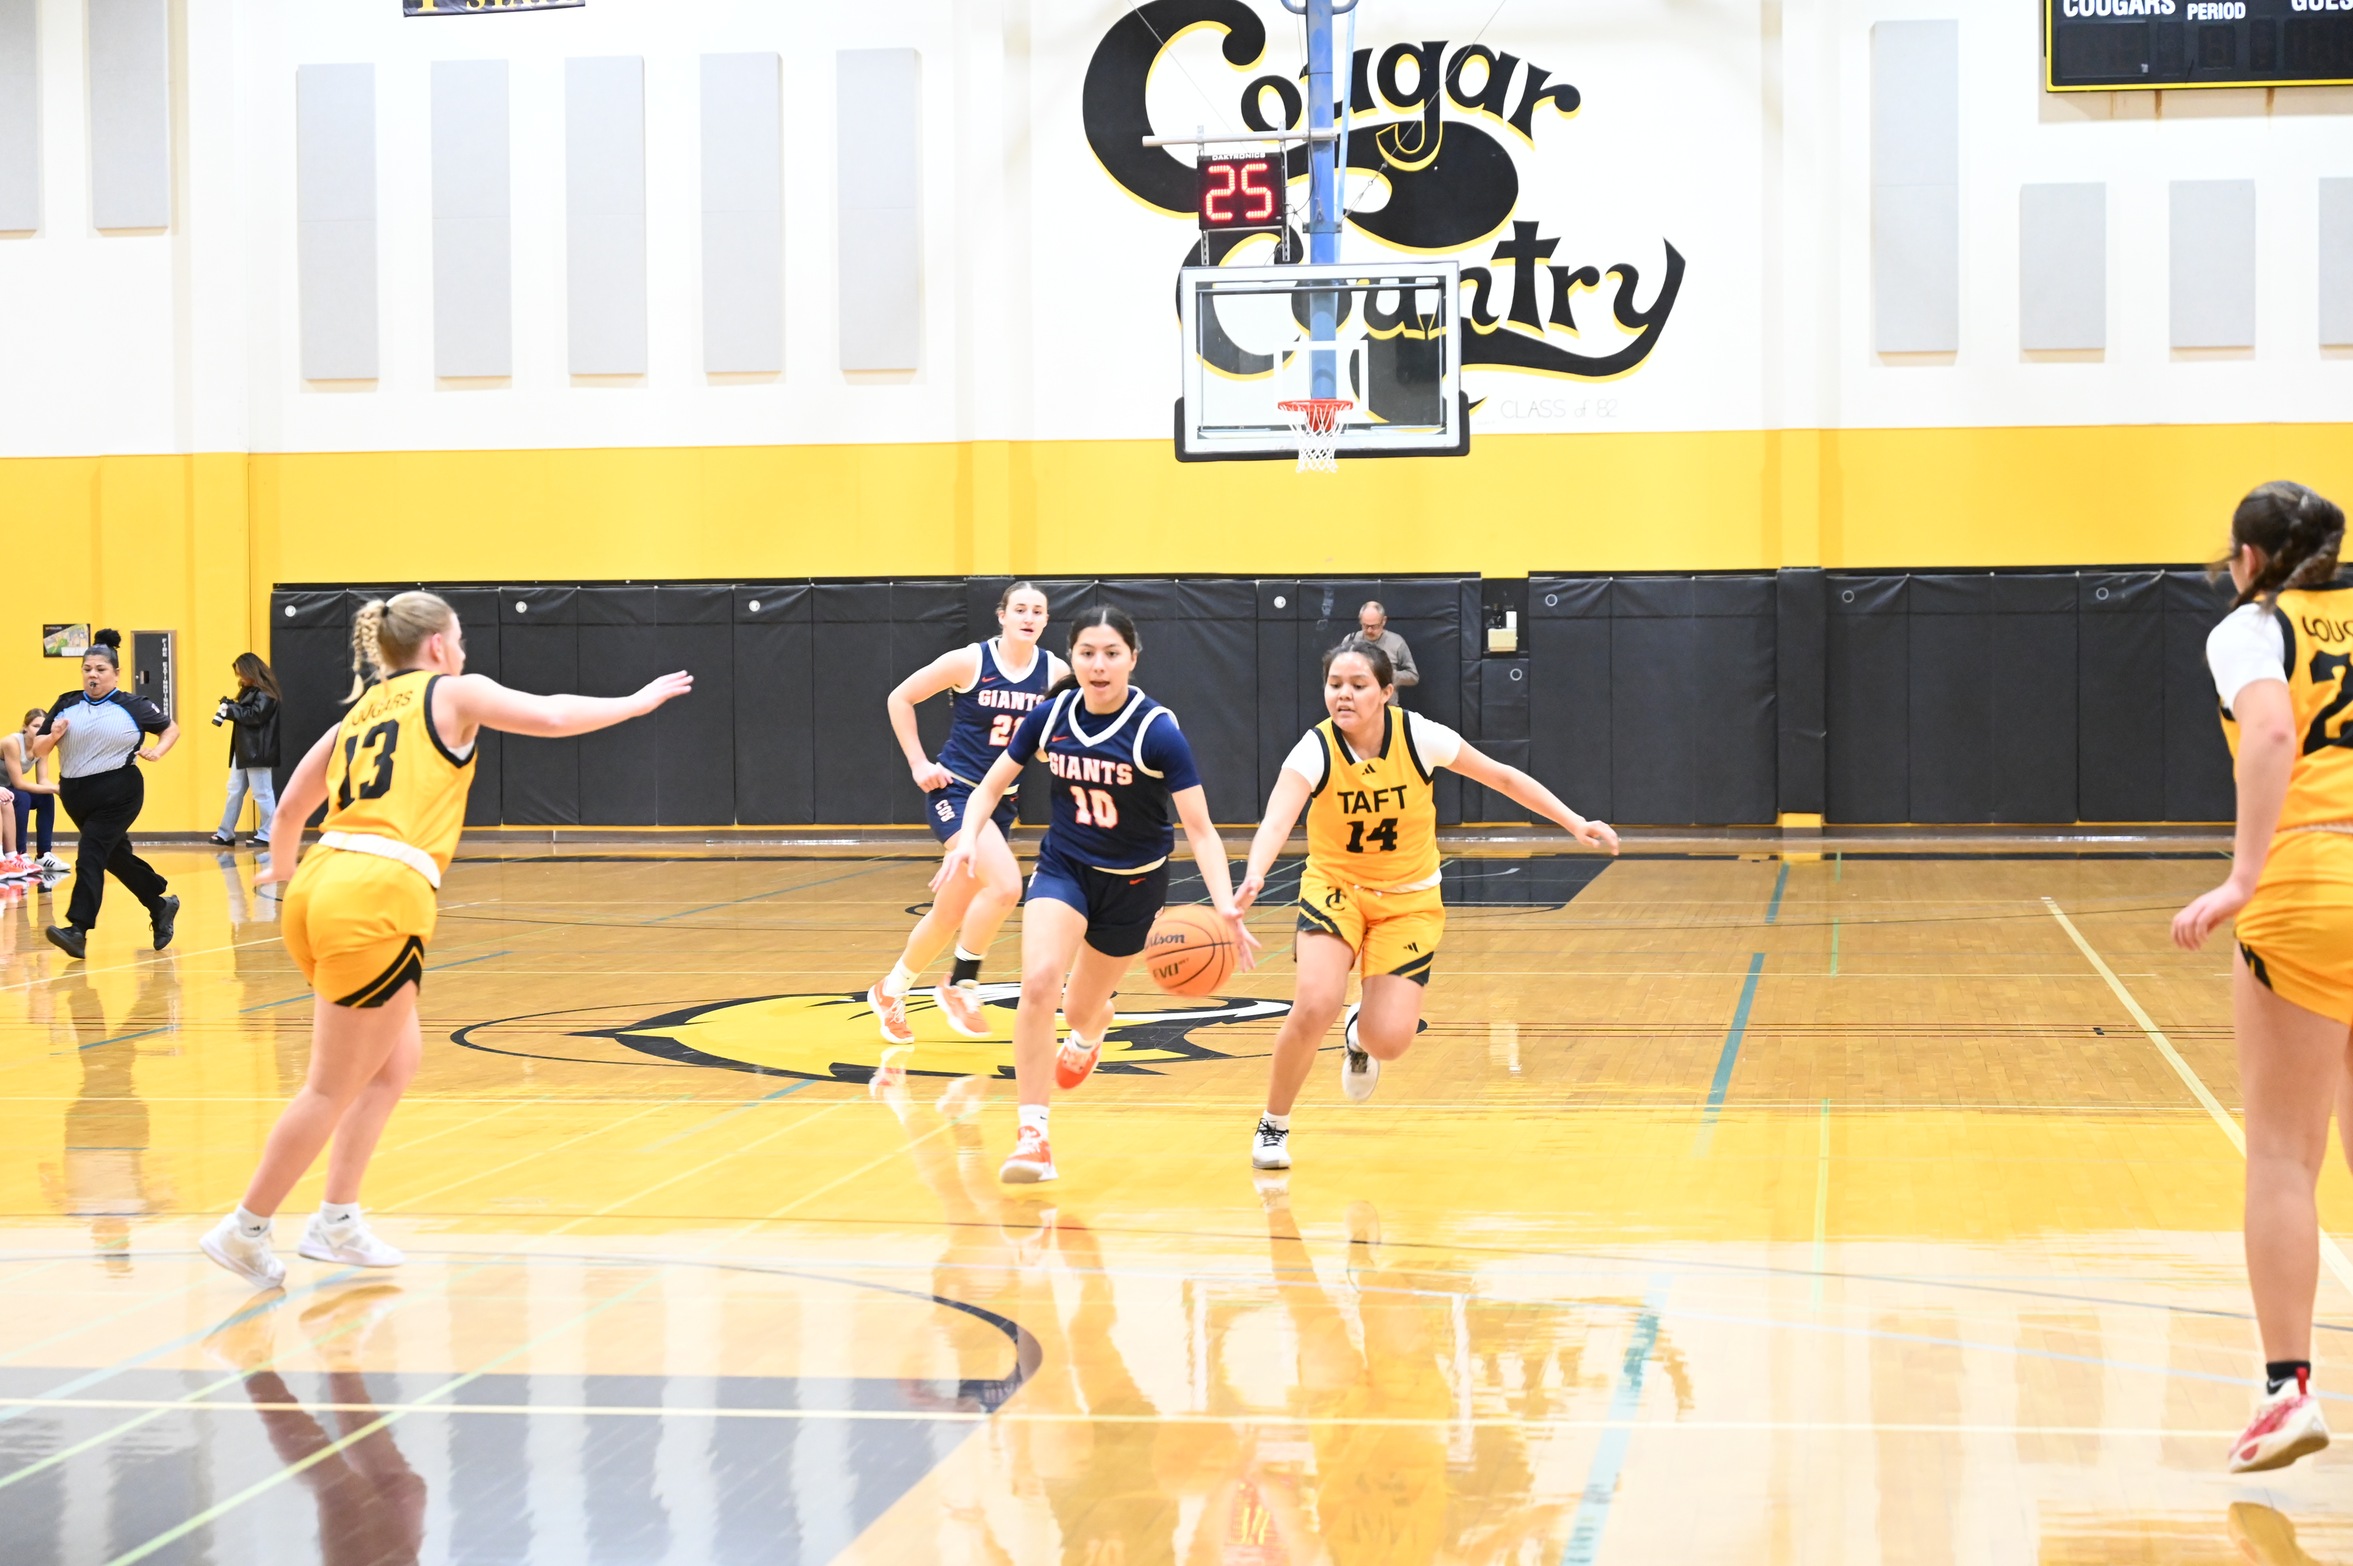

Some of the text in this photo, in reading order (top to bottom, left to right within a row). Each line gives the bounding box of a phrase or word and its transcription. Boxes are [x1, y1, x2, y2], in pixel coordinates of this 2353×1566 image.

[2063, 0, 2176, 17] COUGARS
[2187, 2, 2246, 20] PERIOD
[1206, 163, 1272, 220] 25
[1500, 400, 1566, 419] CLASS
[336, 719, 400, 812] 13
[1048, 752, 1133, 785] GIANTS
[1069, 785, 1119, 829] 10
[1337, 785, 1407, 814] TAFT
[1346, 818, 1398, 853] 14
